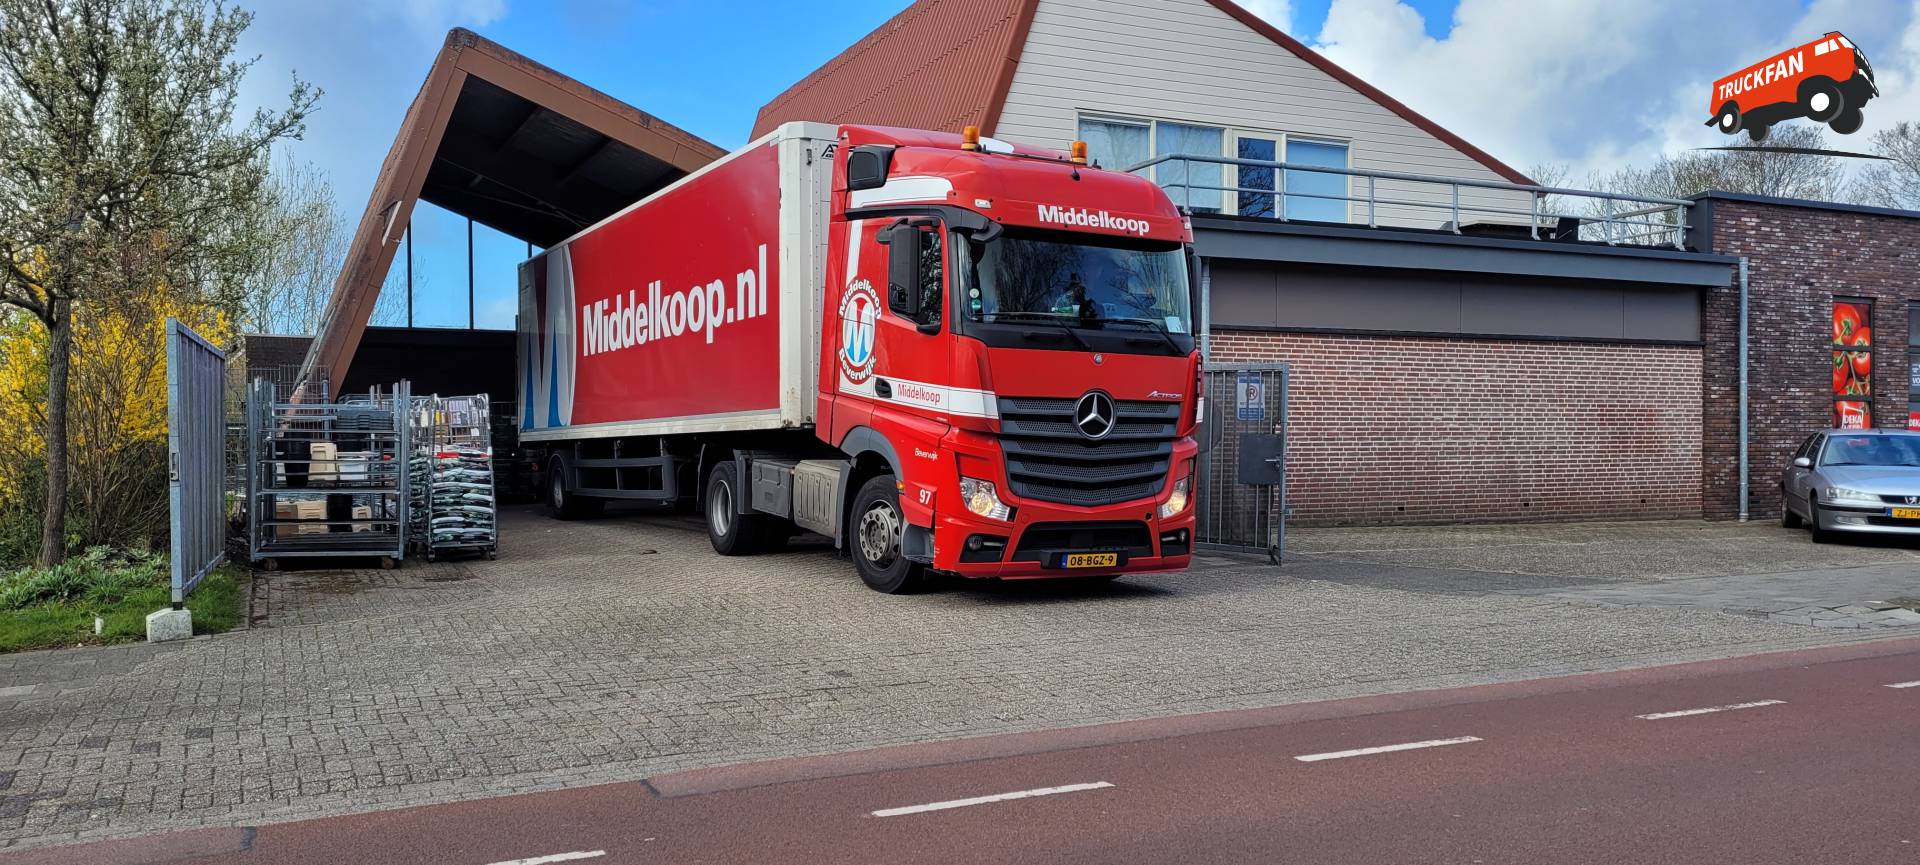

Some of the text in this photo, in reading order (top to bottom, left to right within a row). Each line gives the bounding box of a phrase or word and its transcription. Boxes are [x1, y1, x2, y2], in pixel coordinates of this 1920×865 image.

[1038, 204, 1150, 236] Middelkoop
[583, 244, 767, 357] Middelkoop.nl
[839, 279, 881, 320] Middelkoop
[839, 348, 877, 380] Beverwijk
[897, 384, 941, 404] Middelkoop
[1843, 414, 1863, 424] DEKA
[919, 488, 931, 505] 97
[1070, 555, 1114, 567] 08-BGZ-9
